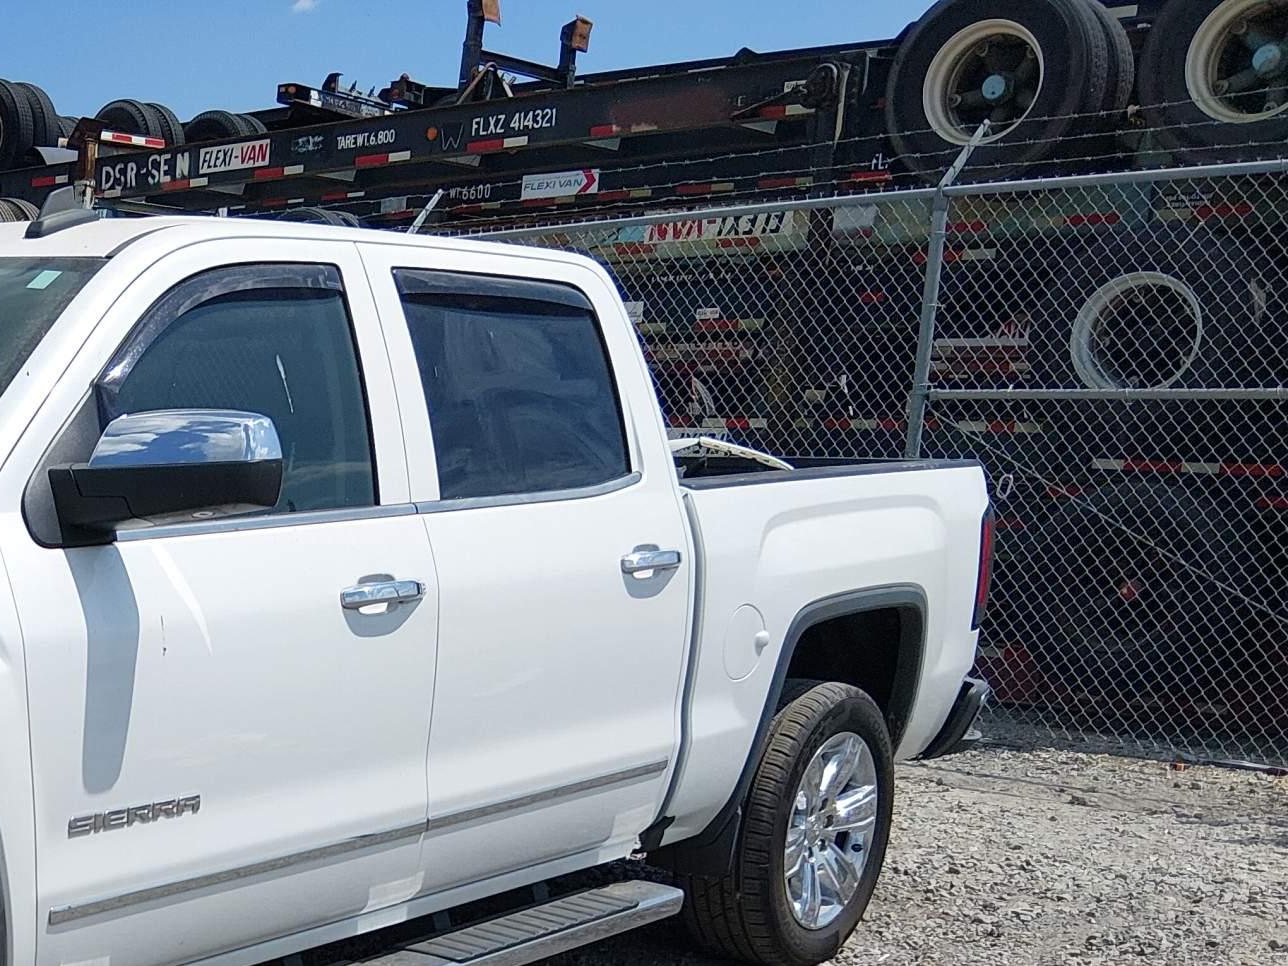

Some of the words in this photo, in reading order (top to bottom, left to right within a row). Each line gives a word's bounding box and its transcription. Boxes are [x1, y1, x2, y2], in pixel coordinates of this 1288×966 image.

[472, 114, 505, 136] FLXZ
[510, 108, 557, 131] 414321
[200, 143, 269, 170] FLEXI-VAN
[523, 181, 556, 192] FLEXI
[559, 178, 584, 189] VAN
[67, 794, 201, 839] SIERRA
